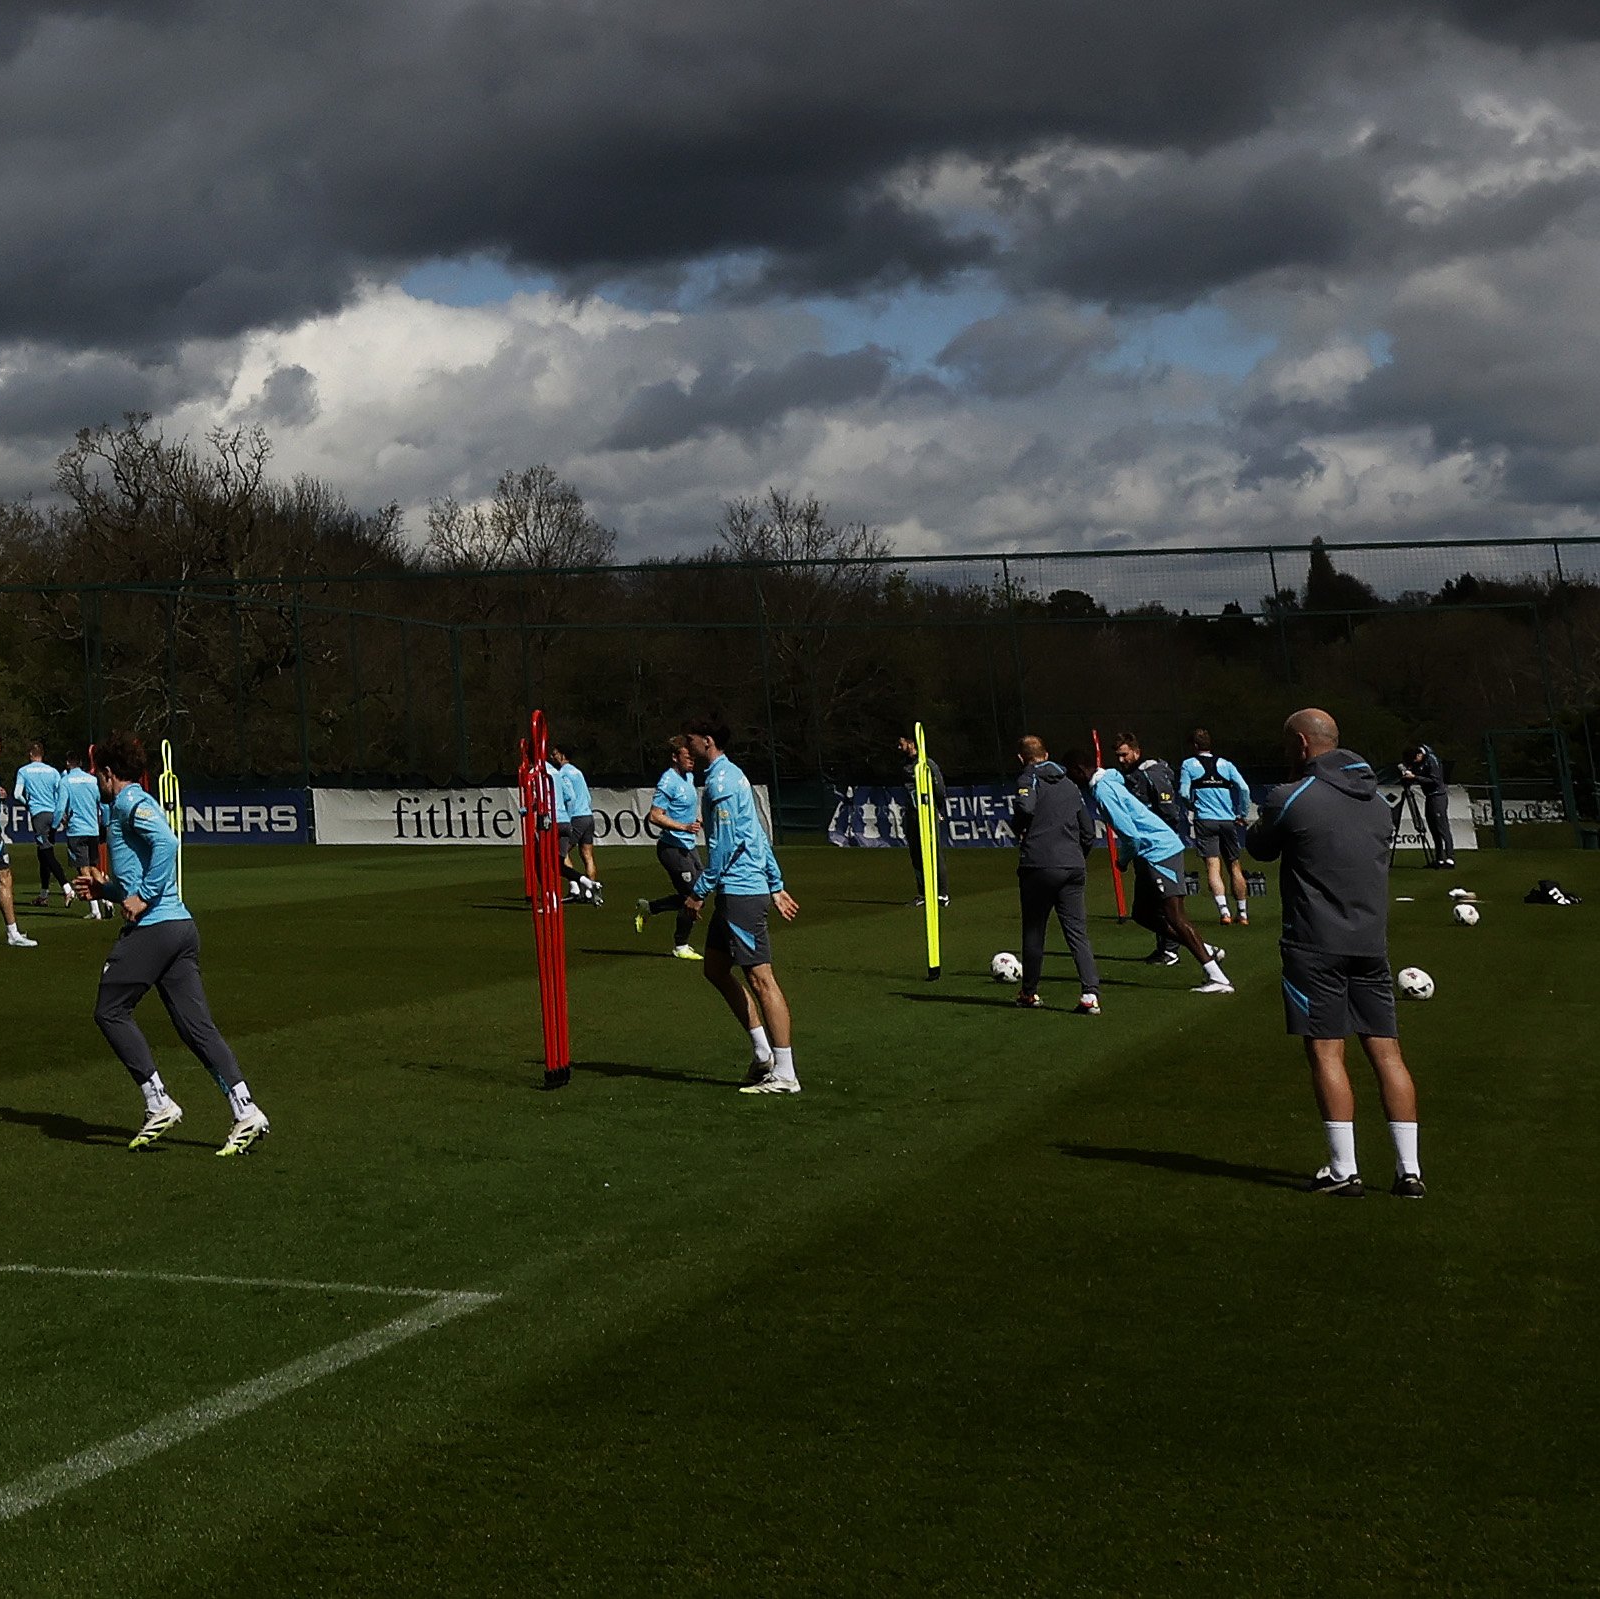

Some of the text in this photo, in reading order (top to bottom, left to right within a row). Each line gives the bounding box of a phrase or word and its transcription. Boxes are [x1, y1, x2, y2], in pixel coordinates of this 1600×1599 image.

[184, 805, 299, 833] NERS
[391, 796, 516, 839] fitlife
[945, 794, 1017, 817] FIVE-T
